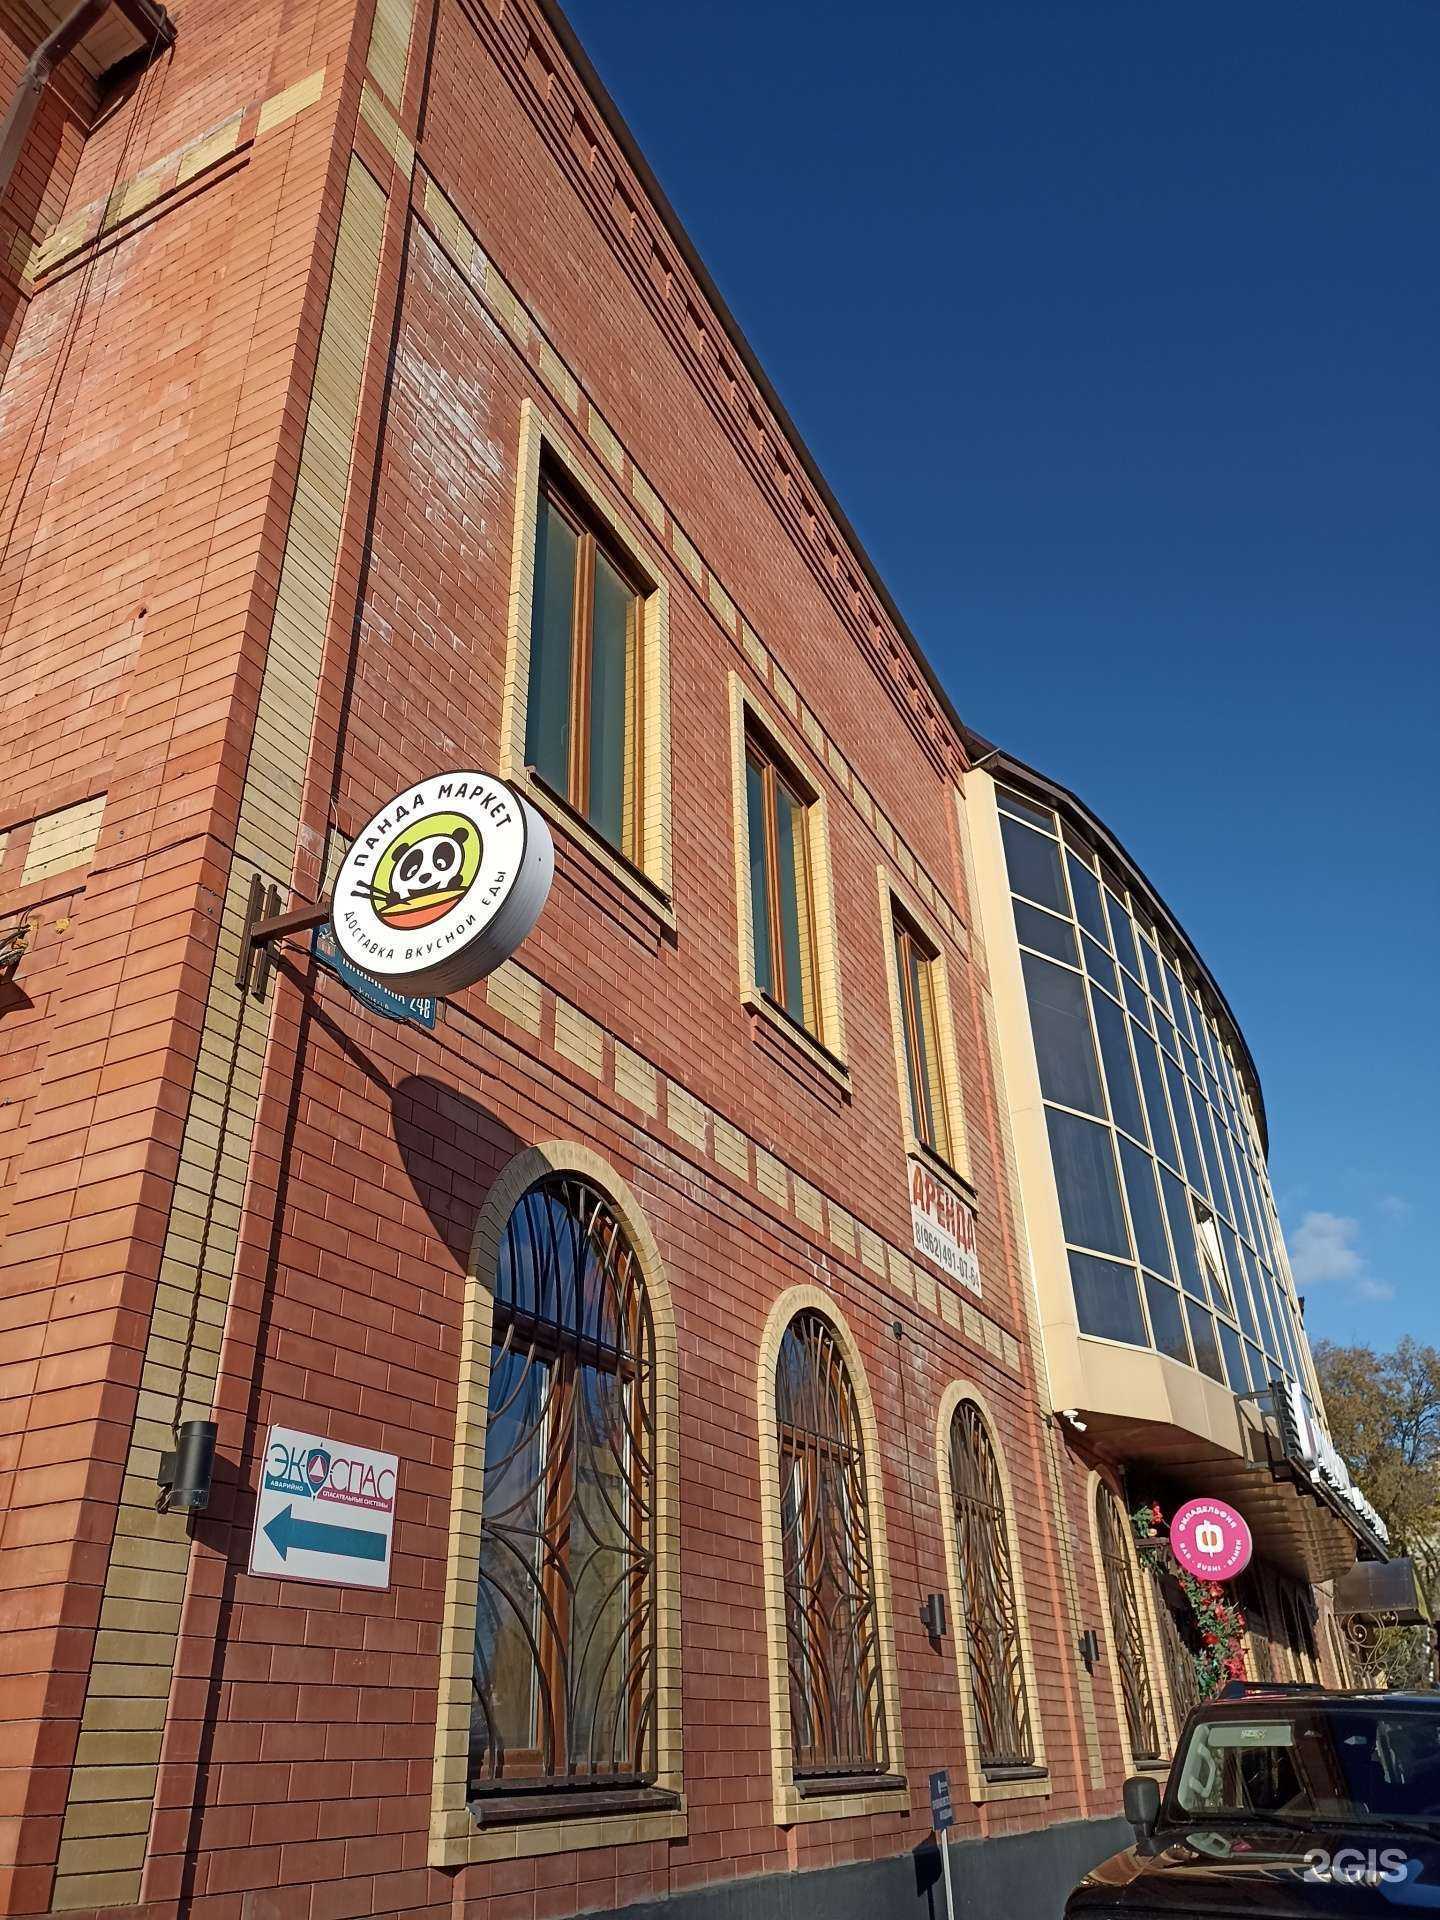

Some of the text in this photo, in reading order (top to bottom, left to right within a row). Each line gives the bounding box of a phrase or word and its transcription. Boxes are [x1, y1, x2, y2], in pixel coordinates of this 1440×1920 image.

[353, 782, 512, 866] ПАНДА МАРКЕТ
[344, 870, 507, 960] ДОСТАВКА ВКУСНОЙ ЕДЫ
[913, 1166, 976, 1255] АРЕНДА
[270, 1480, 304, 1492] АВАРИЙНО
[1178, 1506, 1238, 1532] ФИЛАДЕЛЬФИЯ
